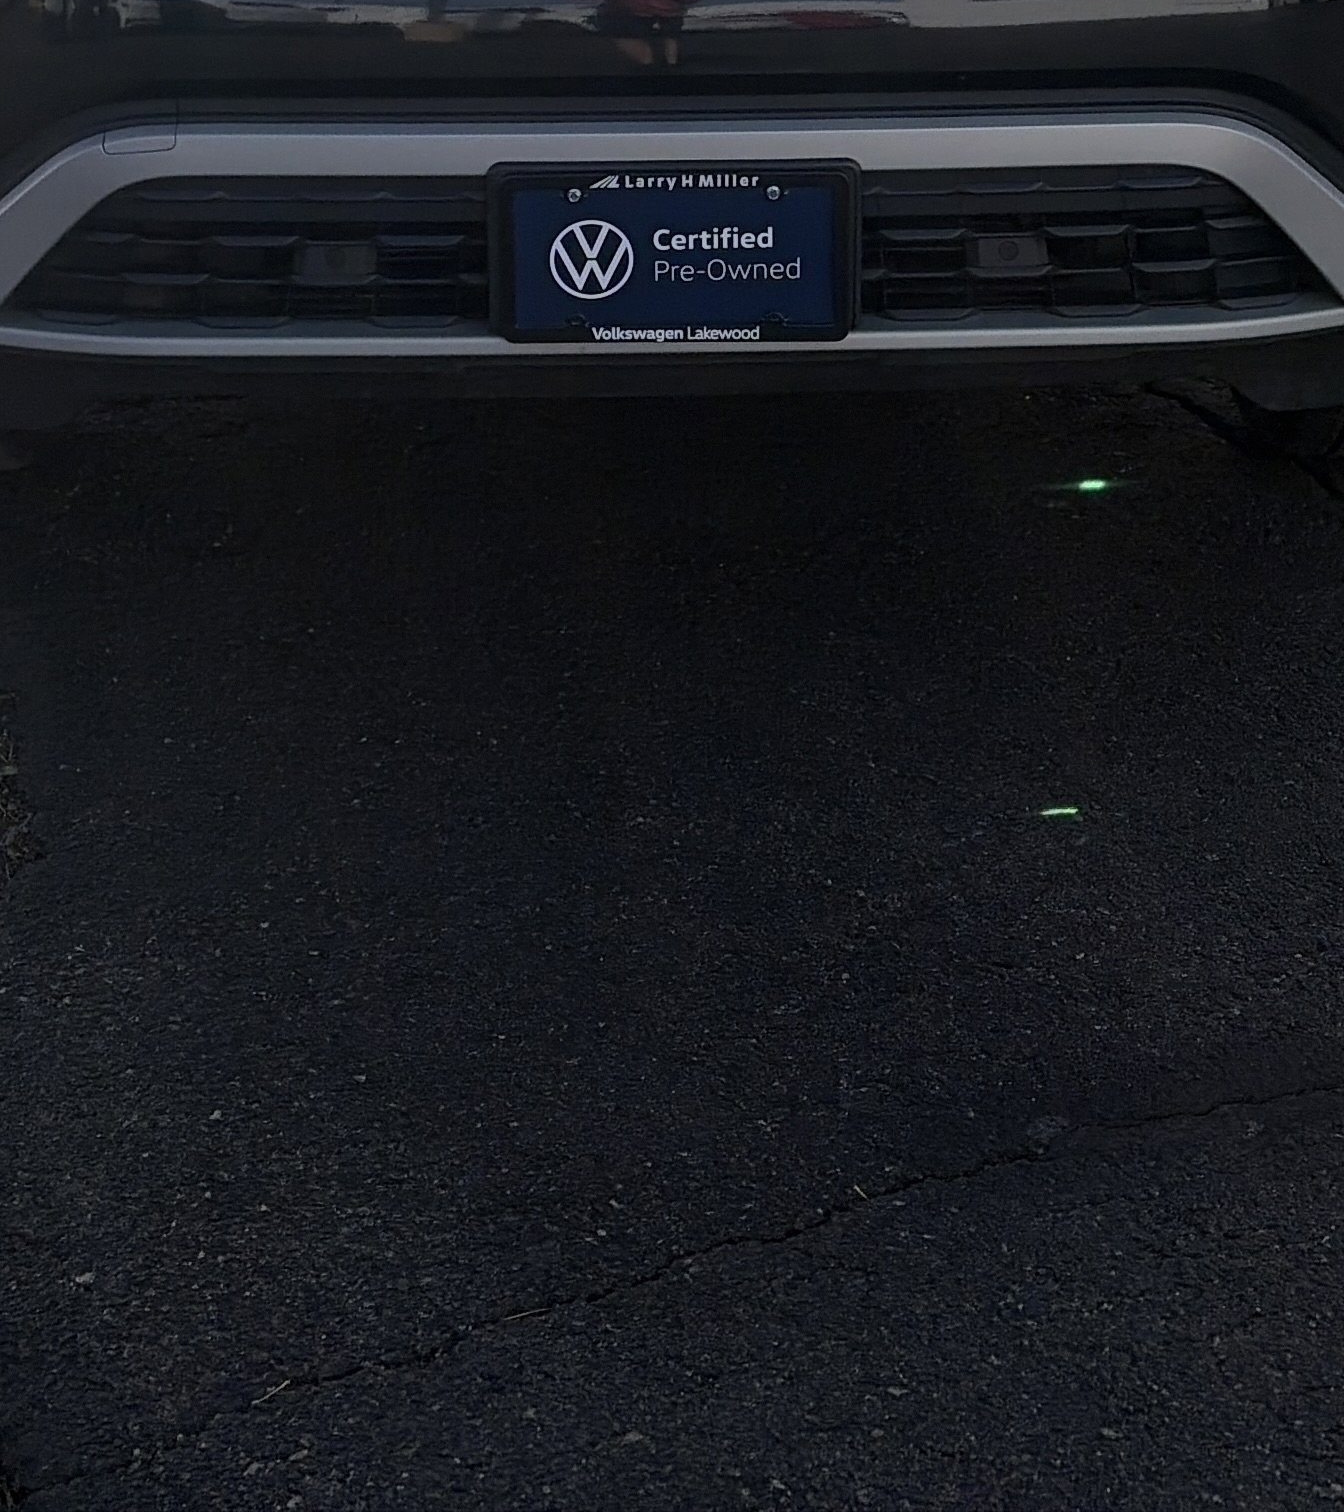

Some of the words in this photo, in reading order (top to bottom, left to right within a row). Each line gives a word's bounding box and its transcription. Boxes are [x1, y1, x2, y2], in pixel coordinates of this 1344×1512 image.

[624, 175, 676, 191] Larry
[681, 174, 693, 188] H
[698, 173, 759, 188] Miller
[652, 227, 774, 251] Certified
[550, 220, 634, 299] VW
[654, 257, 801, 282] Pre-Owned
[592, 326, 684, 342] Volkswagen
[687, 325, 760, 340] Lakewood
